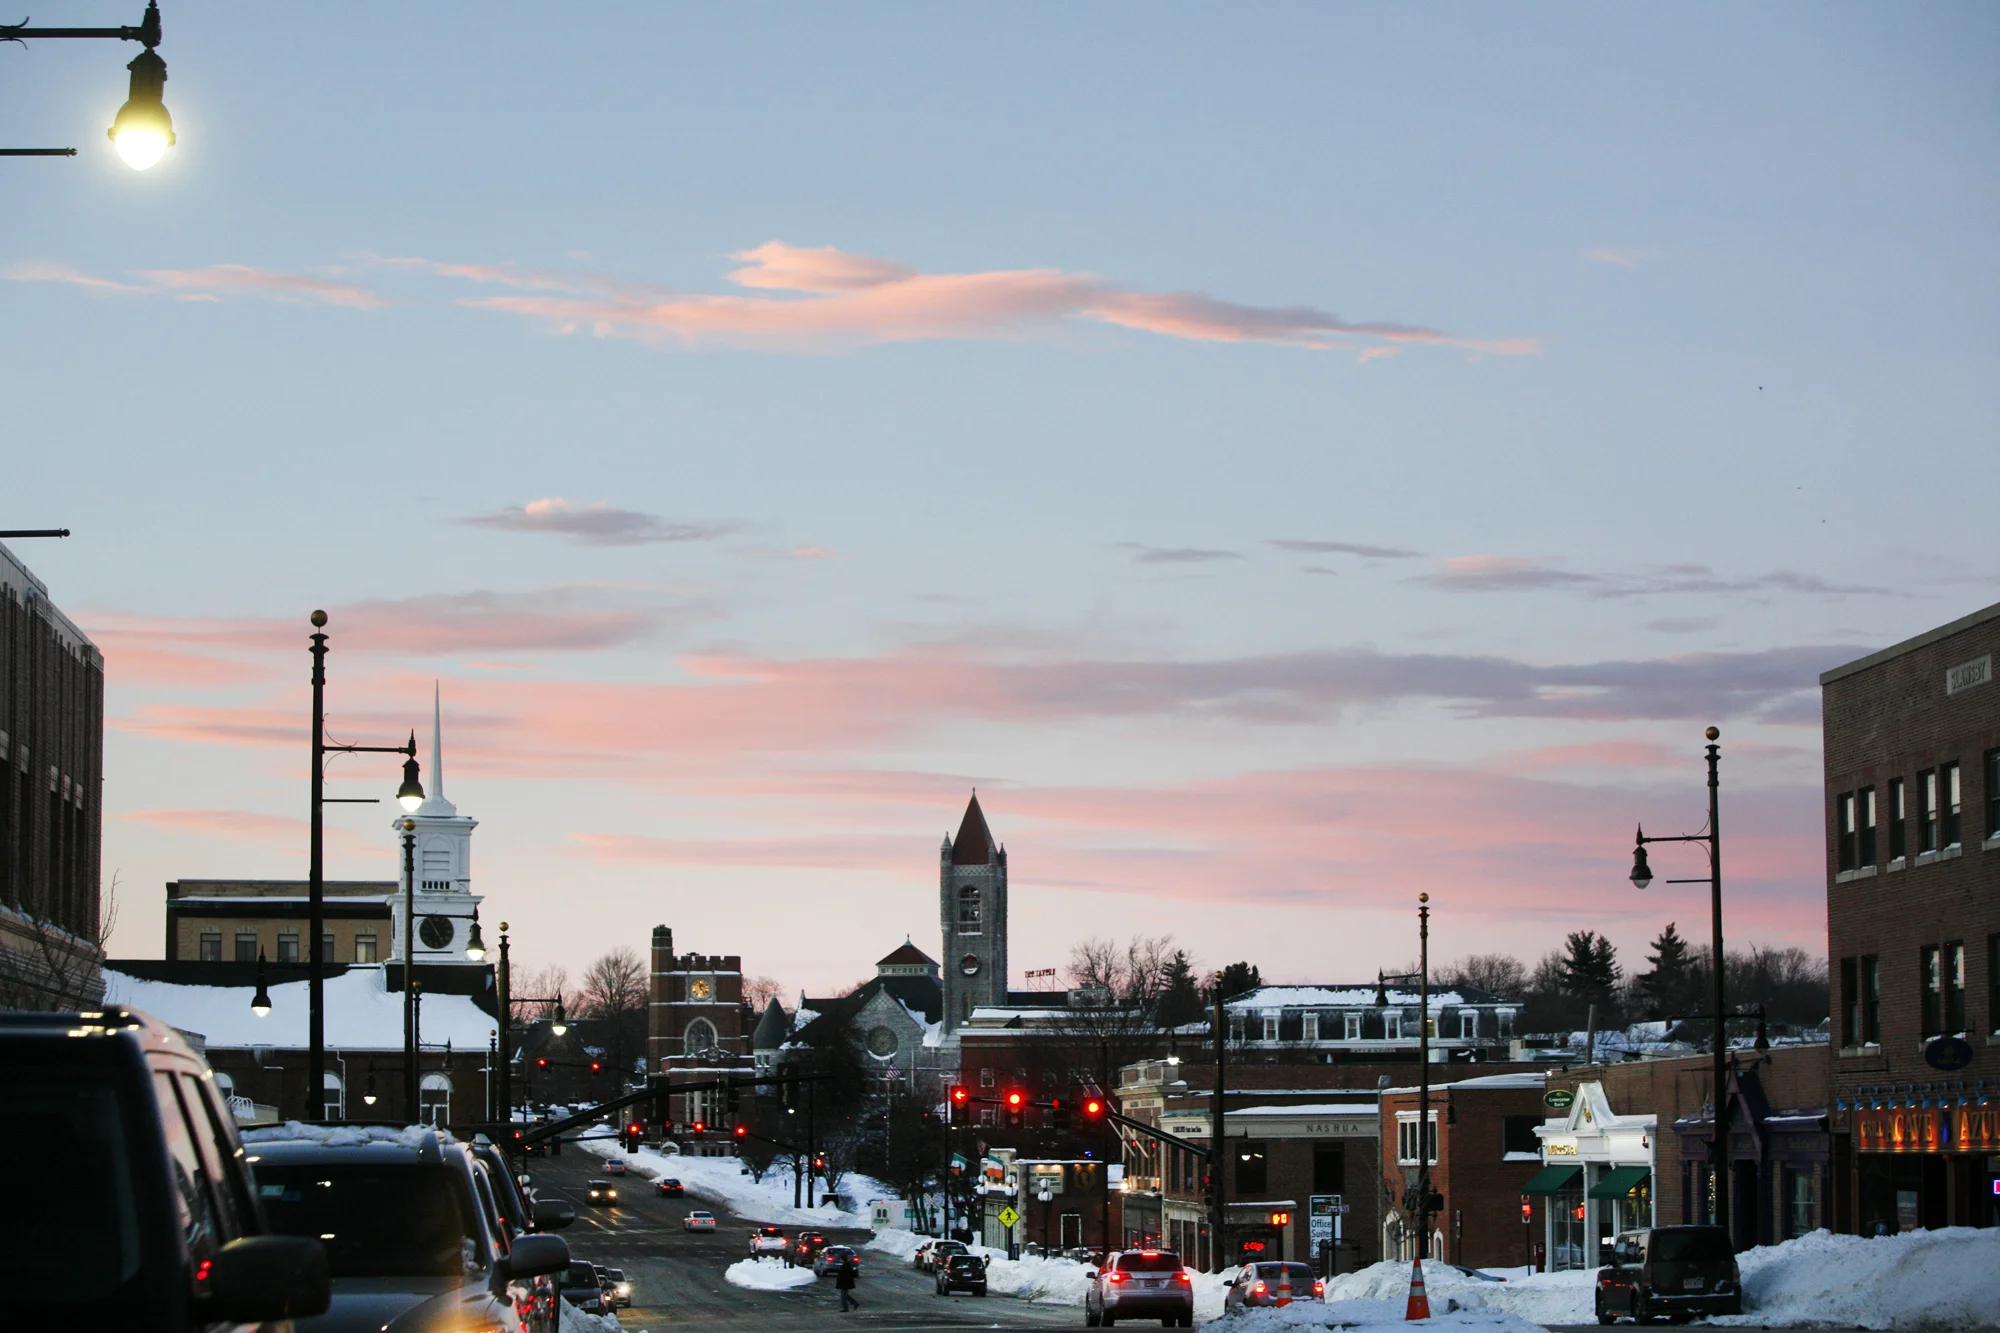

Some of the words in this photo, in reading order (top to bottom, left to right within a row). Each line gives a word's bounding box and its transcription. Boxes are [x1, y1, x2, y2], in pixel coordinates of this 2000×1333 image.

[1306, 1124, 1358, 1133] NASHUA
[1886, 1113, 1934, 1143] AGAVE
[1959, 1110, 2000, 1141] AZUL
[1311, 1219, 1332, 1228] Office
[1311, 1229, 1334, 1238] Suites
